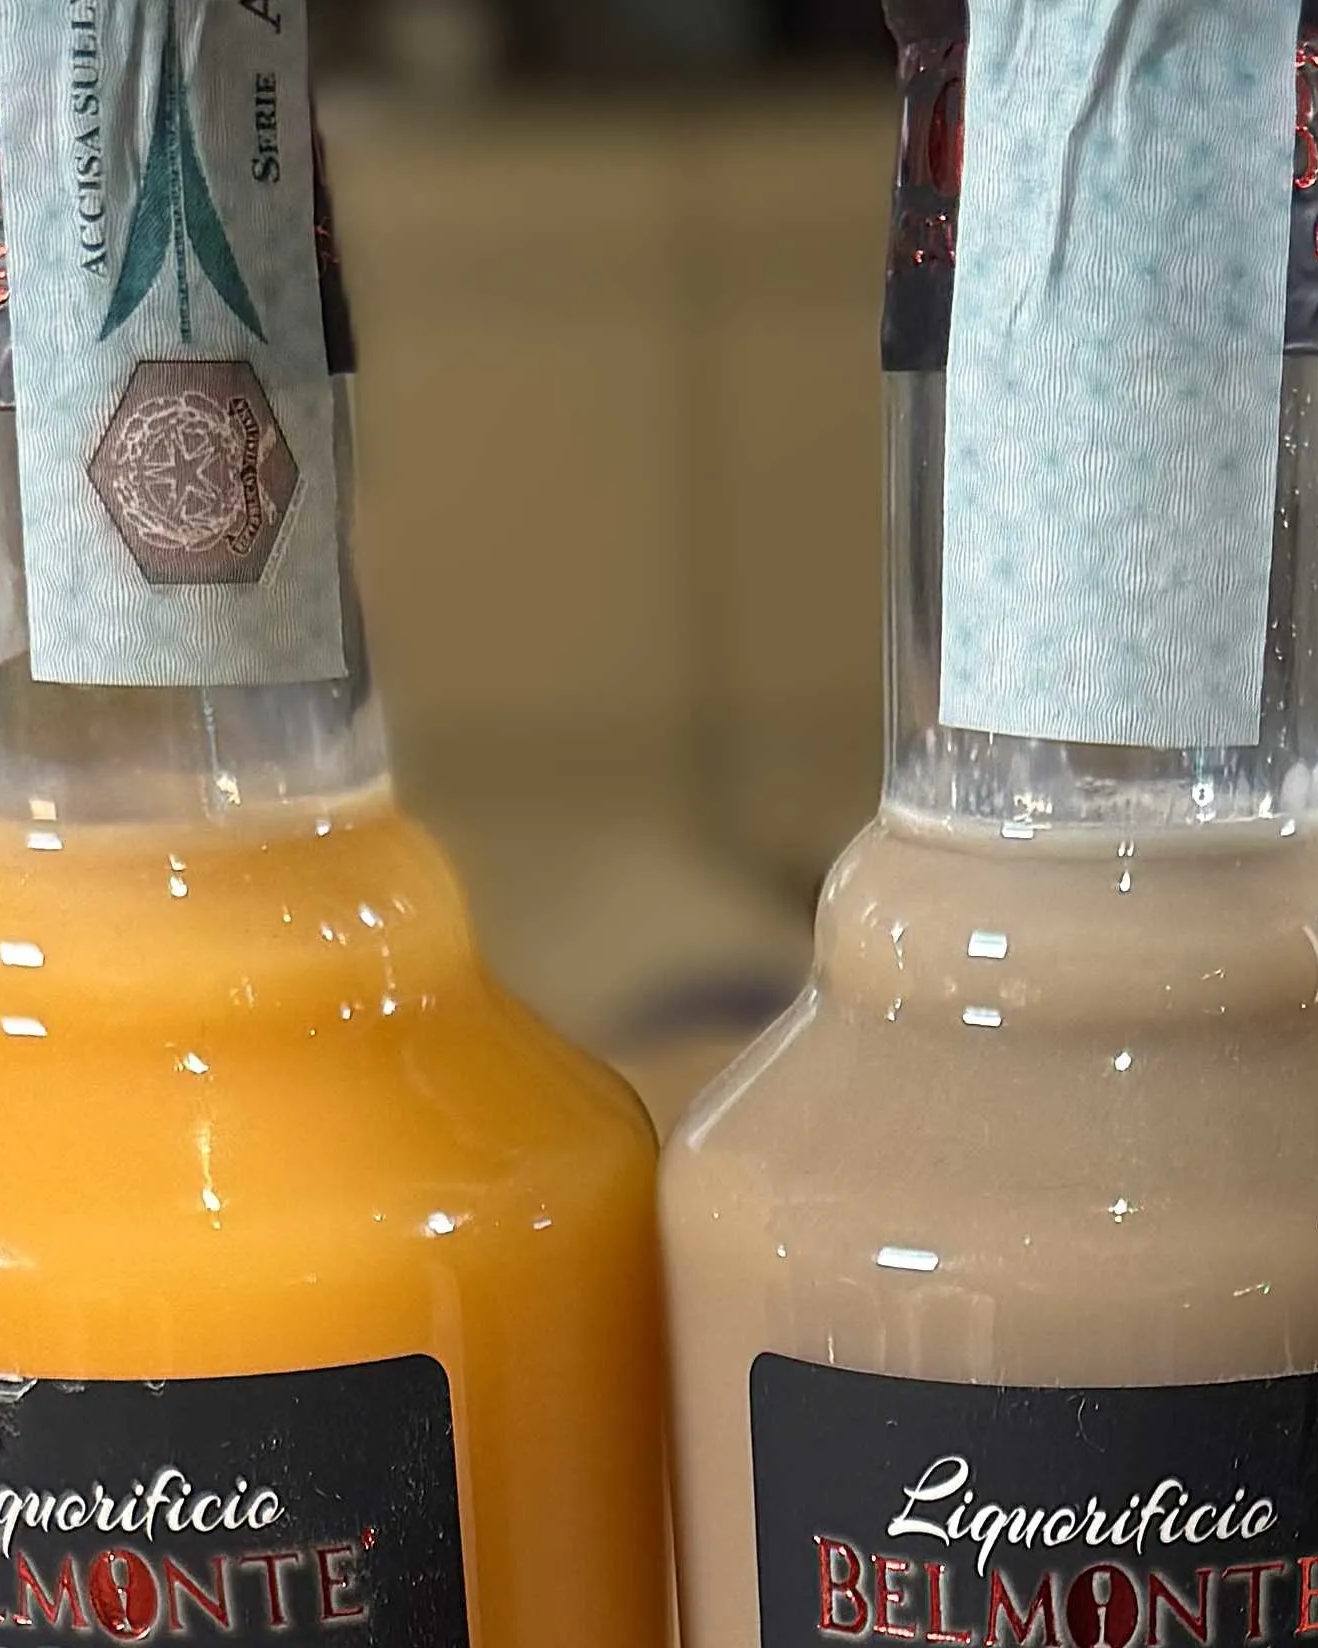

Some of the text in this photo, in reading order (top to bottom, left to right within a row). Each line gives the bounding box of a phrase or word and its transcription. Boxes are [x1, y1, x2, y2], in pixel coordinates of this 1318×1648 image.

[253, 72, 281, 184] SERIE
[74, 127, 107, 278] ACCISA
[886, 1455, 1279, 1577] Liquorificio
